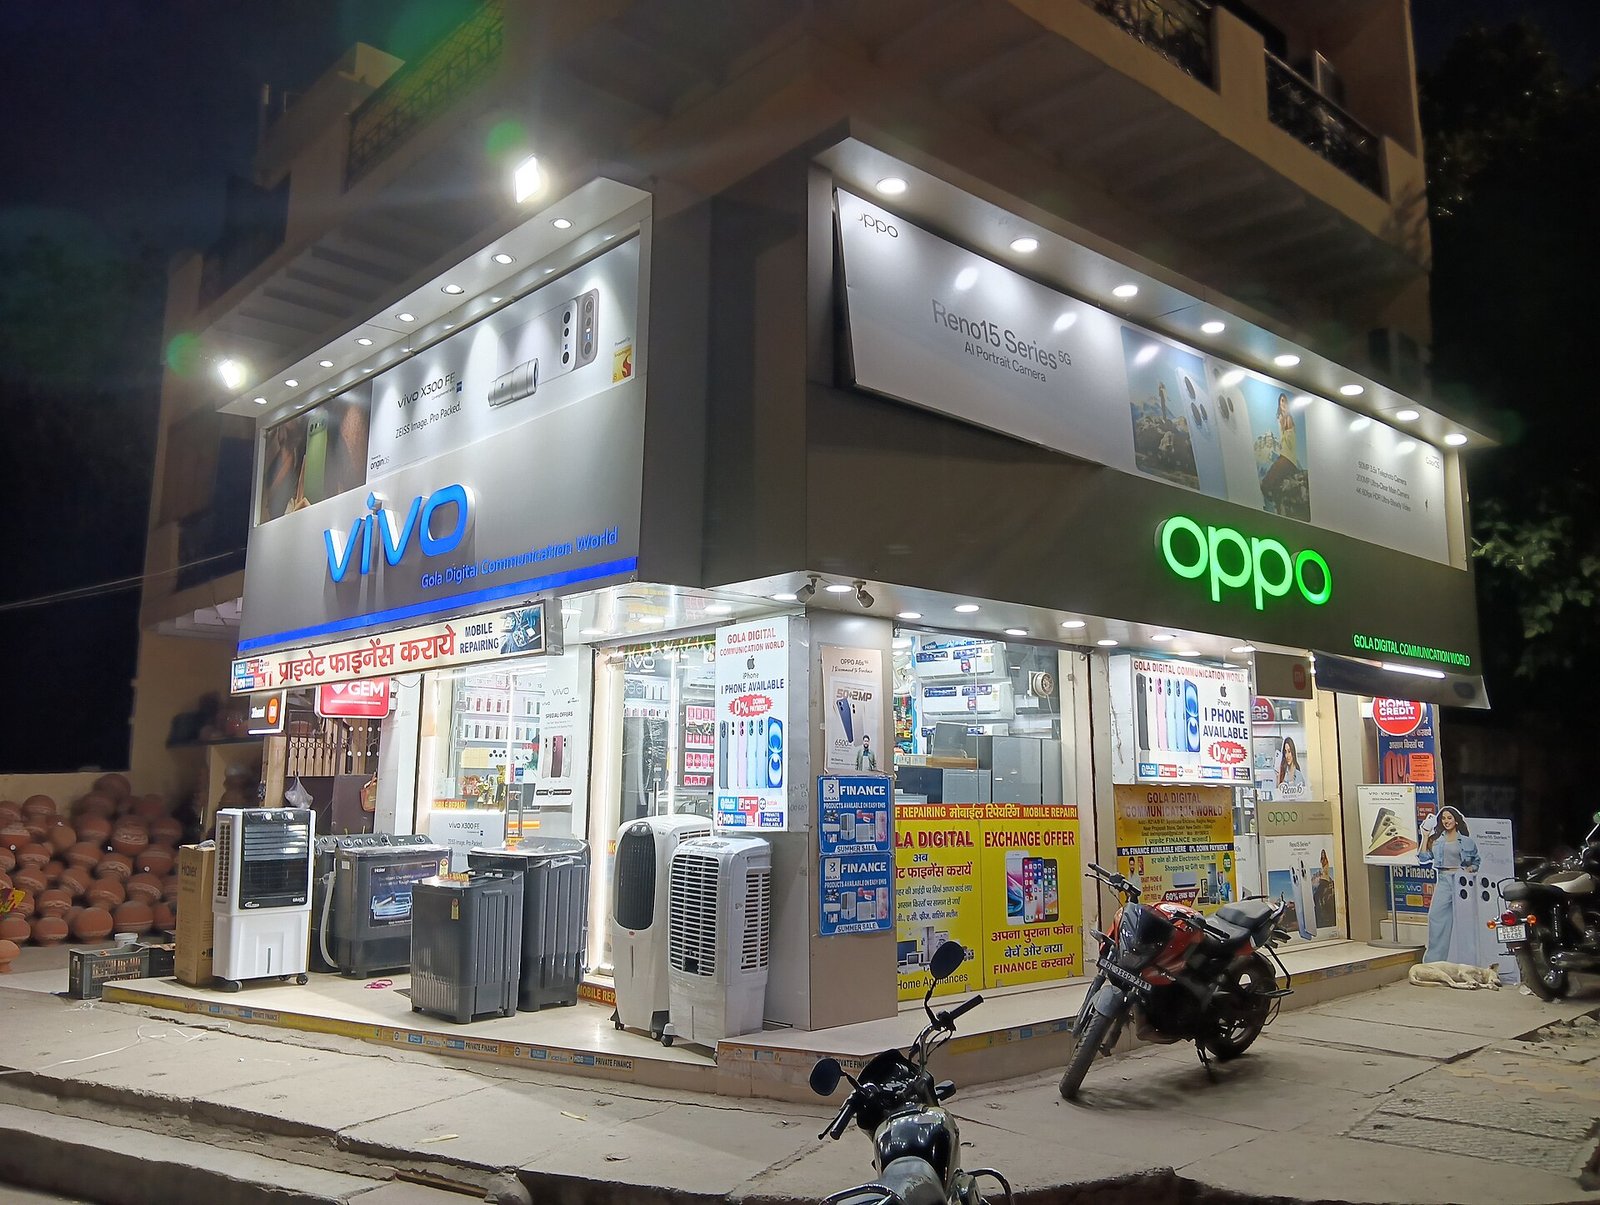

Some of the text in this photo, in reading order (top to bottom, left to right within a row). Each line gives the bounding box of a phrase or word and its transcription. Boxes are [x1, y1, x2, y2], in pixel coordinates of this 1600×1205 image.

[932, 299, 1072, 369] Reno15 Series 5G
[965, 342, 1047, 382] AI Portrait Camera
[397, 371, 455, 408] vivo X300 FE
[395, 401, 461, 439] ZEISS Image. Pro Packed.
[324, 483, 468, 582] vivo
[421, 525, 618, 588] Gola Digital Communication World
[1162, 516, 1332, 610] oppo
[464, 622, 493, 637] MOBILE
[727, 628, 776, 644] GOLA DIGITAL
[459, 636, 499, 654] REPAIRING
[720, 641, 784, 656] COMMUNICATION WORLD
[1354, 634, 1470, 666] GOLA DIGITAL COMMUNICATION WORLD
[279, 650, 326, 684] प्राइवेट
[329, 638, 395, 674] फाइनेंस
[400, 624, 457, 662] कराये
[1134, 661, 1245, 682] GOLA DIGITAL COMMUNICATION WORLD
[348, 681, 384, 697] GEM
[552, 687, 569, 696] vivo
[725, 683, 746, 694] PHONE
[748, 679, 784, 692] AVAILABLE
[734, 700, 748, 714] 0%
[1379, 699, 1410, 707] HOME
[1204, 707, 1208, 721] I
[1211, 708, 1245, 724] PHONE
[1379, 707, 1415, 715] CREDIT
[1203, 724, 1249, 740] AVAILABLE
[835, 739, 848, 747] 6500
[1213, 744, 1231, 761] 0%
[840, 786, 886, 796] FINANCE
[1147, 792, 1201, 803] GOLA DIGITAL
[903, 806, 946, 818] REPAIRING
[1023, 807, 1049, 817] MOBILE
[1051, 807, 1076, 818] REPAIRI
[1126, 805, 1223, 817] COMMUNICATION WORLD
[1267, 811, 1298, 826] oppo
[449, 821, 460, 829] vivo
[895, 831, 974, 847] LA DIGITAL
[985, 831, 1074, 847] EXCHANGE OFFER
[182, 865, 197, 877] Haier
[841, 862, 887, 873] FINANCE
[908, 863, 943, 879] फाइनेंस
[947, 861, 972, 876] करायें
[1165, 864, 1185, 872] Shopping
[1406, 866, 1435, 879] Finance
[1406, 884, 1421, 892] vivo
[1166, 892, 1178, 901] 60%
[991, 923, 1074, 943] अपना पुराना फोन
[1023, 943, 1042, 956] और
[1044, 944, 1063, 954] नया
[994, 953, 1075, 974] FINANCE करवायें
[897, 979, 921, 990] Home
[580, 986, 616, 1002] MOBILE REP
[466, 1042, 498, 1053] PRIVATE FINANCE
[596, 1057, 632, 1069] PRIVATE FINANCE
